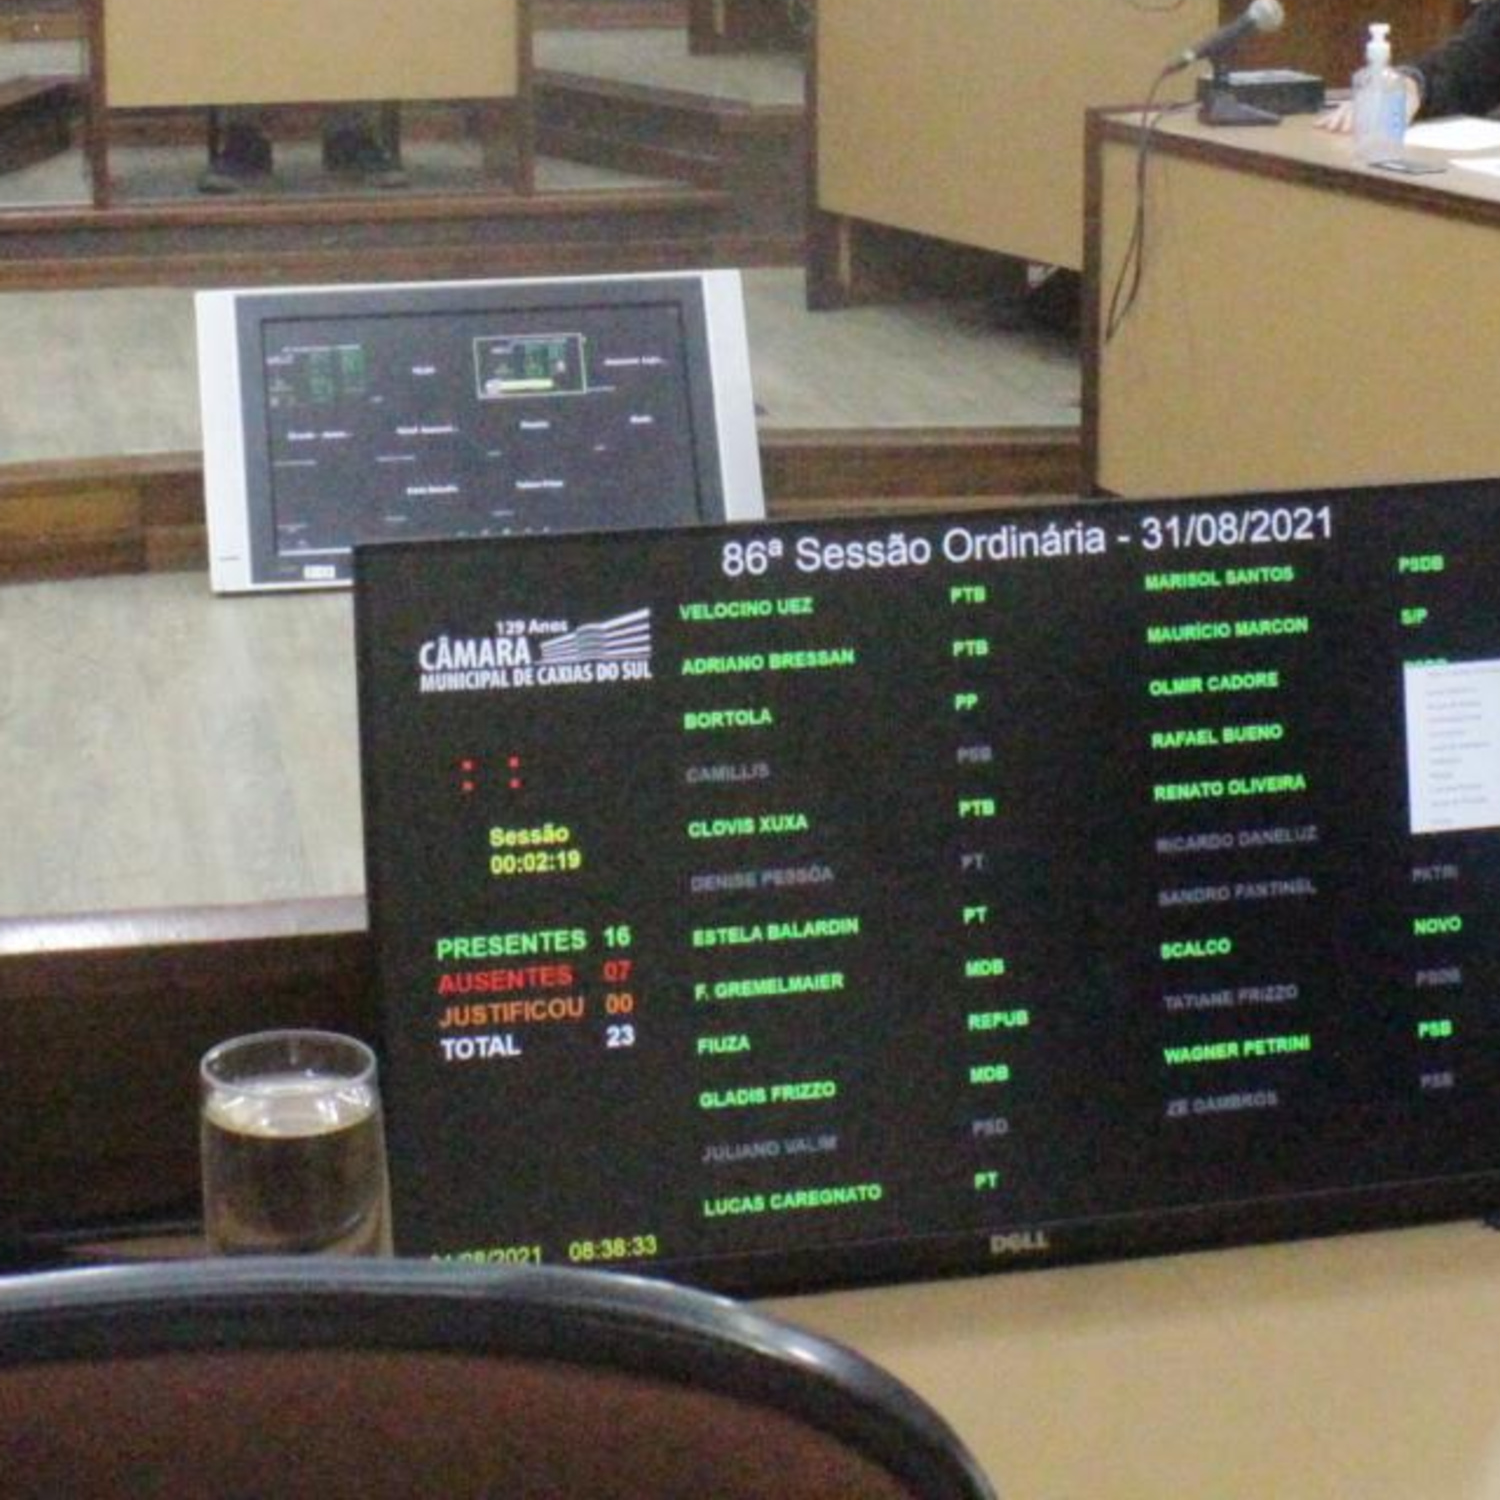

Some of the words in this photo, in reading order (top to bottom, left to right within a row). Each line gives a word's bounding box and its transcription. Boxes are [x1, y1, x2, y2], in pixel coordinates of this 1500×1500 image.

[722, 537, 783, 576] 86ª
[796, 533, 931, 572] Sessão
[943, 520, 1106, 562] Ordinária
[1141, 506, 1332, 549] 31/08/2021
[1145, 571, 1221, 591] MARISOL
[1225, 566, 1294, 586] SANTOS
[951, 586, 986, 603] PTB
[679, 599, 772, 620] VELOCINO
[777, 596, 814, 615] UEZ
[1235, 617, 1309, 638] MARCON
[419, 634, 532, 672] CÂMARA
[953, 640, 988, 657] PTB
[681, 654, 764, 675] ADRIANO
[768, 649, 856, 670] BRESSAN
[420, 667, 510, 693] MUNICIPAL
[513, 666, 535, 687] DE
[537, 662, 593, 685] CAXIAS
[596, 660, 619, 681] DO
[622, 659, 653, 680] SUL
[1207, 671, 1279, 691] CADORE
[955, 694, 979, 711] PP
[683, 708, 773, 730] BORTOLA
[1152, 728, 1219, 749] RAFAEL
[1222, 723, 1284, 744] BUENO
[1154, 780, 1224, 802] RENATO
[1228, 774, 1307, 796] OLIVEIRA
[958, 799, 995, 818] PTB
[489, 822, 570, 847] Sessão
[688, 817, 754, 839] CLOVIS
[758, 813, 809, 835] XUXA
[490, 849, 582, 876] 00:02:19
[963, 906, 987, 924] PT
[1414, 916, 1462, 936] NOVO
[436, 929, 588, 961] PRESENTES
[603, 926, 632, 948] 16
[693, 926, 763, 947] ESTELA
[768, 918, 860, 941] BALARDIN
[1160, 937, 1232, 959] SCALCO
[438, 964, 575, 995] AUSENTES
[603, 960, 632, 982] 07
[440, 997, 585, 1029] JUSTIFICOU
[605, 993, 634, 1015] 00
[1418, 1019, 1453, 1038] PSB
[440, 1033, 522, 1061] TOTAL
[606, 1024, 636, 1048] 23
[698, 1034, 751, 1055] FIUZA
[1164, 1042, 1239, 1065] WAGNER
[1243, 1034, 1311, 1056] PETRINI
[700, 1086, 767, 1109] GLADIS
[771, 1080, 836, 1102] FRIZZO
[974, 1171, 999, 1190] PT
[704, 1196, 765, 1217] LUCAS
[769, 1183, 883, 1209] CAREGNATO
